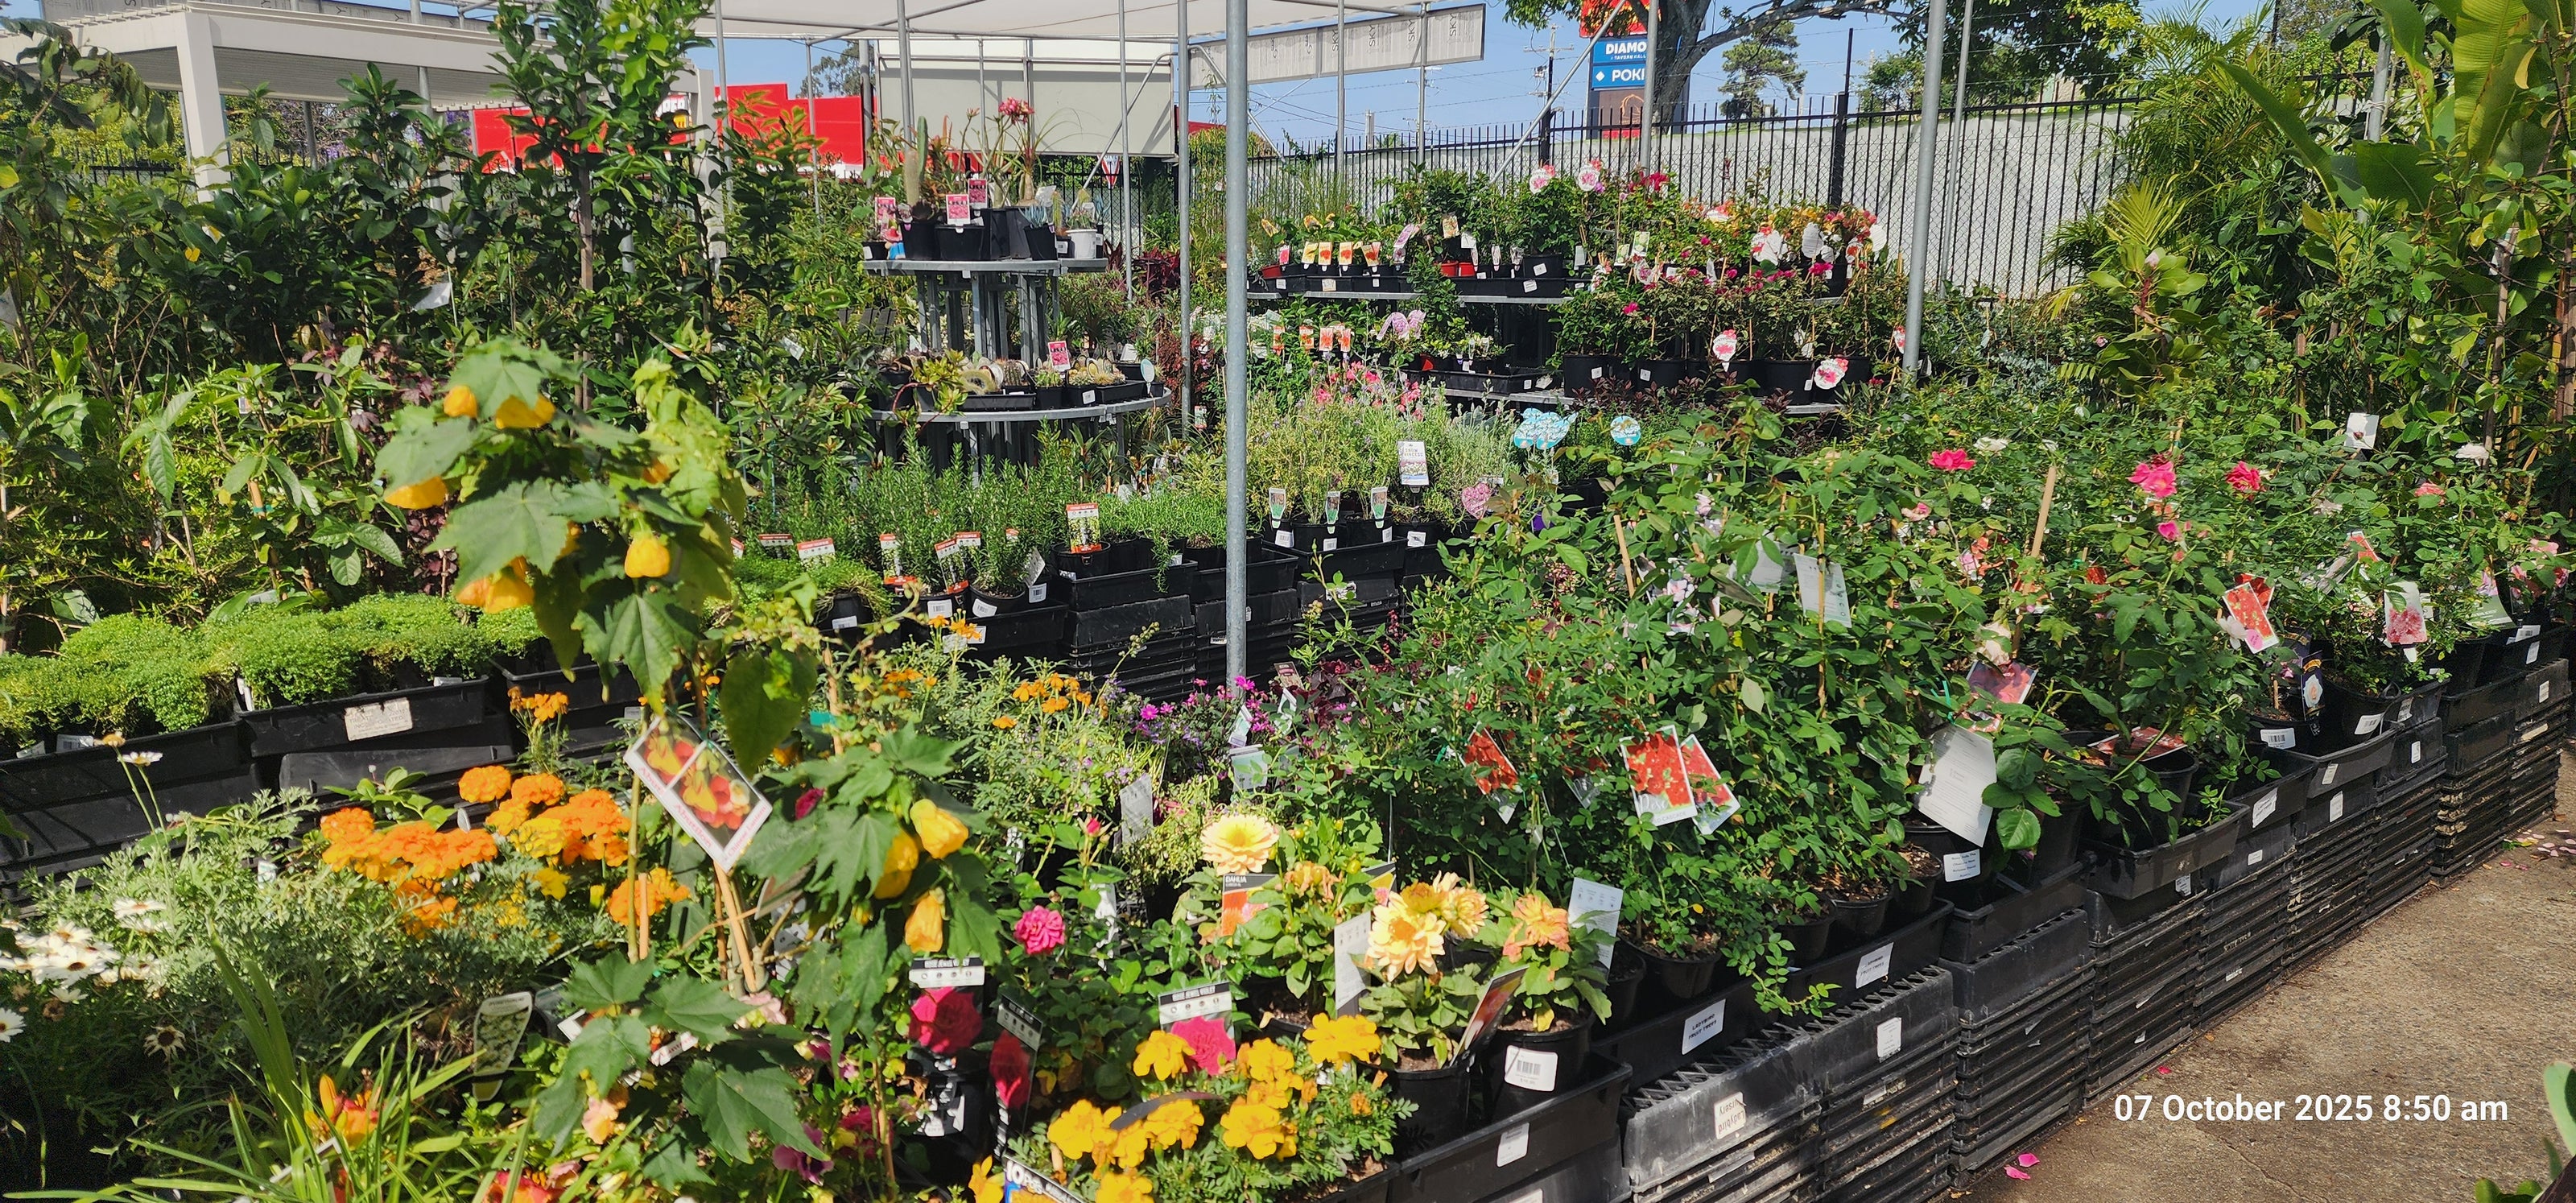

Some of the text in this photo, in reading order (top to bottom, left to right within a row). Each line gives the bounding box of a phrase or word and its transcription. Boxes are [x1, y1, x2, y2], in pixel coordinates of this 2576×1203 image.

[1606, 41, 1648, 55] DIAMO
[1612, 68, 1645, 81] POKI
[1225, 875, 1247, 883] DAHLIA
[1719, 1098, 1740, 1117] ursery
